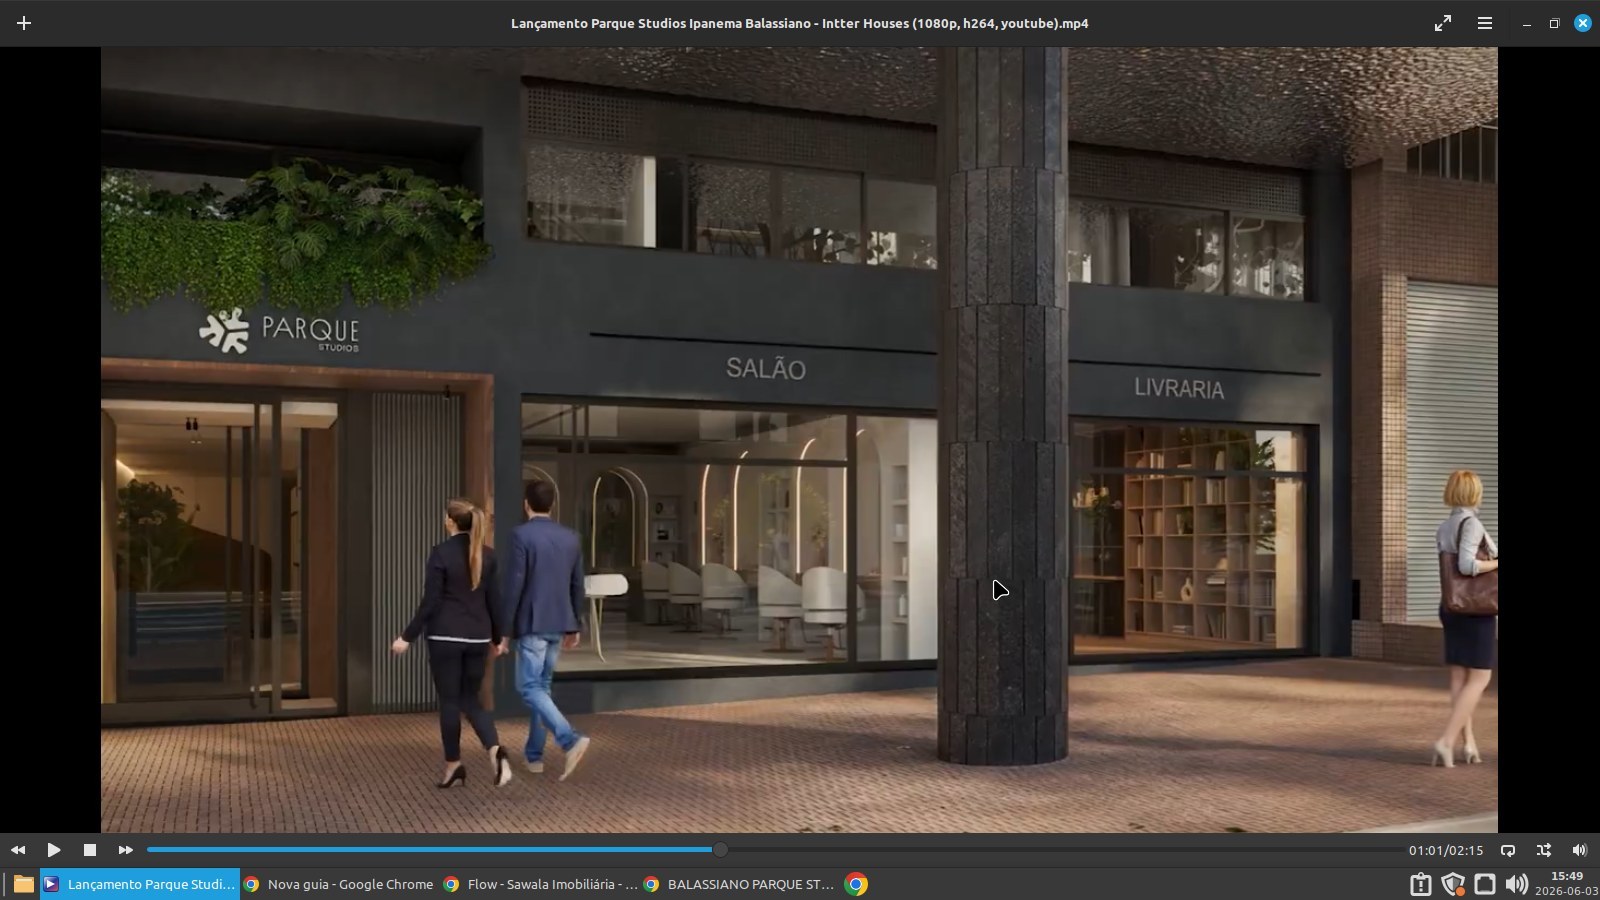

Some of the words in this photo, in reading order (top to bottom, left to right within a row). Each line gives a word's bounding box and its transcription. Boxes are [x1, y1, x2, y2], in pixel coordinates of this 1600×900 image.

[511, 18, 589, 32] Lançamento
[591, 18, 635, 31] Parque
[637, 17, 687, 29] Studios
[689, 18, 743, 31] Ipanema
[745, 17, 812, 29] Balassiano
[822, 18, 861, 29] Intter
[863, 18, 910, 29] Houses
[912, 17, 961, 31] (1080p,
[963, 17, 999, 31] h264,
[1000, 17, 1089, 31] youtube).mp4
[263, 315, 360, 342] PARQUE
[318, 343, 360, 352] STUDIOS
[726, 355, 806, 381] SALÃO
[1135, 376, 1225, 400] LIVRARIA
[1409, 843, 1484, 858] 01:01/02:15
[1551, 871, 1584, 881] 15:49
[68, 879, 143, 892] Lançamento
[145, 879, 189, 892] Parque
[268, 879, 300, 890] Nova
[303, 878, 329, 892] guia
[339, 878, 384, 892] Google
[386, 878, 434, 890] Chrome
[468, 878, 498, 890] Flow
[507, 878, 549, 890] Sawala
[552, 878, 615, 890] Imobiliária
[668, 879, 750, 890] BALASSIANO
[752, 879, 803, 892] PARQUE
[1535, 886, 1599, 896] 2026-06-03
